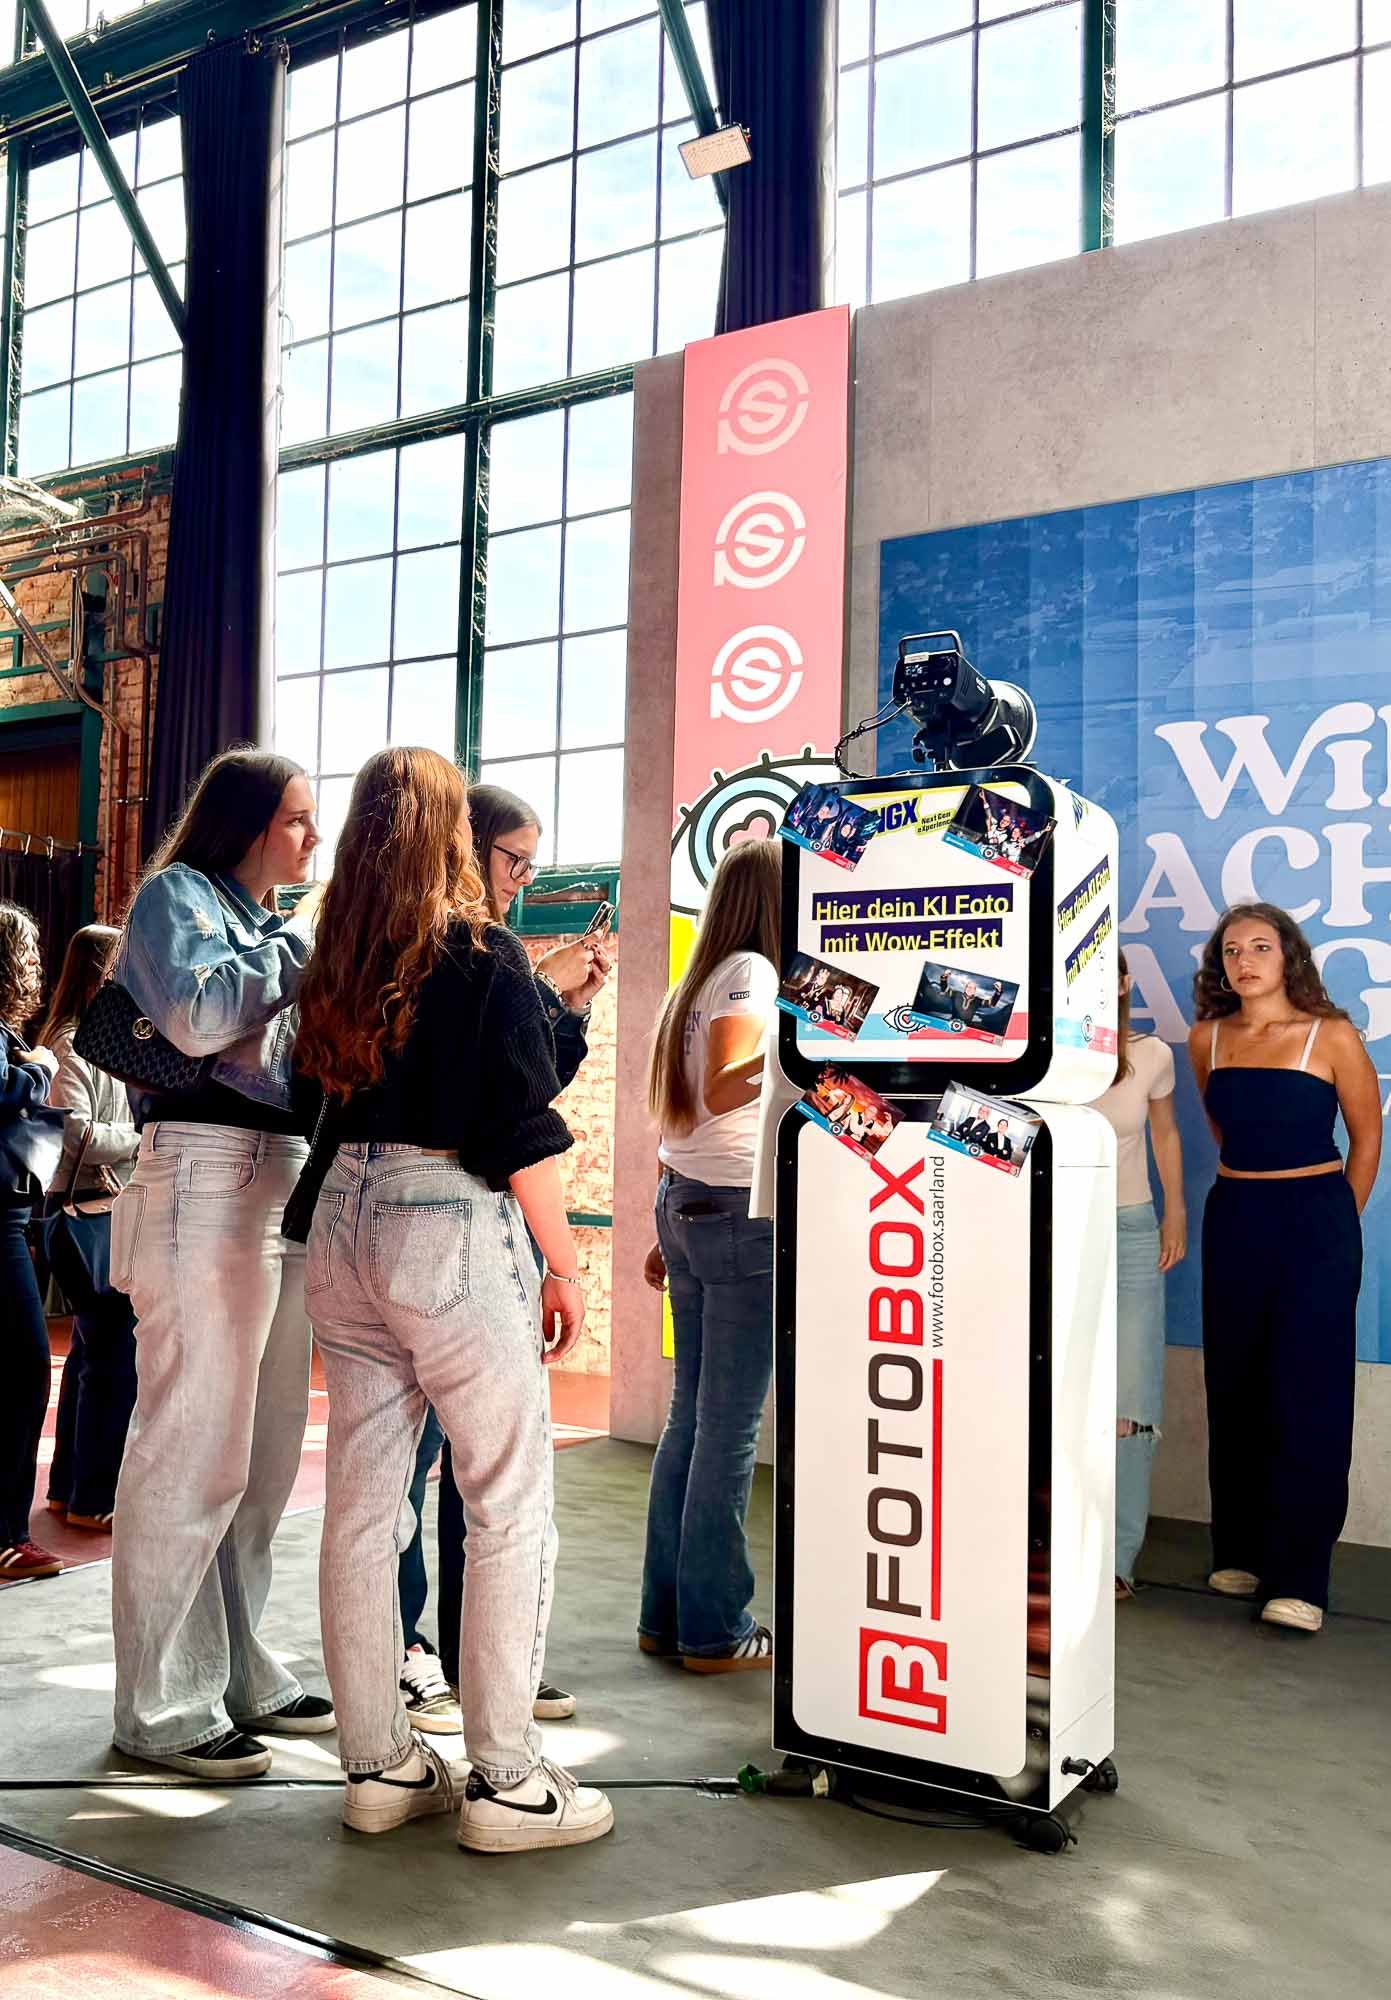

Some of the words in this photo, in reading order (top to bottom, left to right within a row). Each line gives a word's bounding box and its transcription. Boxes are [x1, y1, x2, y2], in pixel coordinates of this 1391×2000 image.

[816, 900, 861, 921] Hier
[867, 898, 916, 919] dein
[923, 896, 947, 915] KI
[955, 894, 1009, 914] Foto
[824, 932, 859, 953] mit
[865, 928, 999, 952] Wow-Effekt
[931, 1155, 946, 1349] www.fotobox.saarland
[865, 1157, 925, 1619] FOTOBOX
